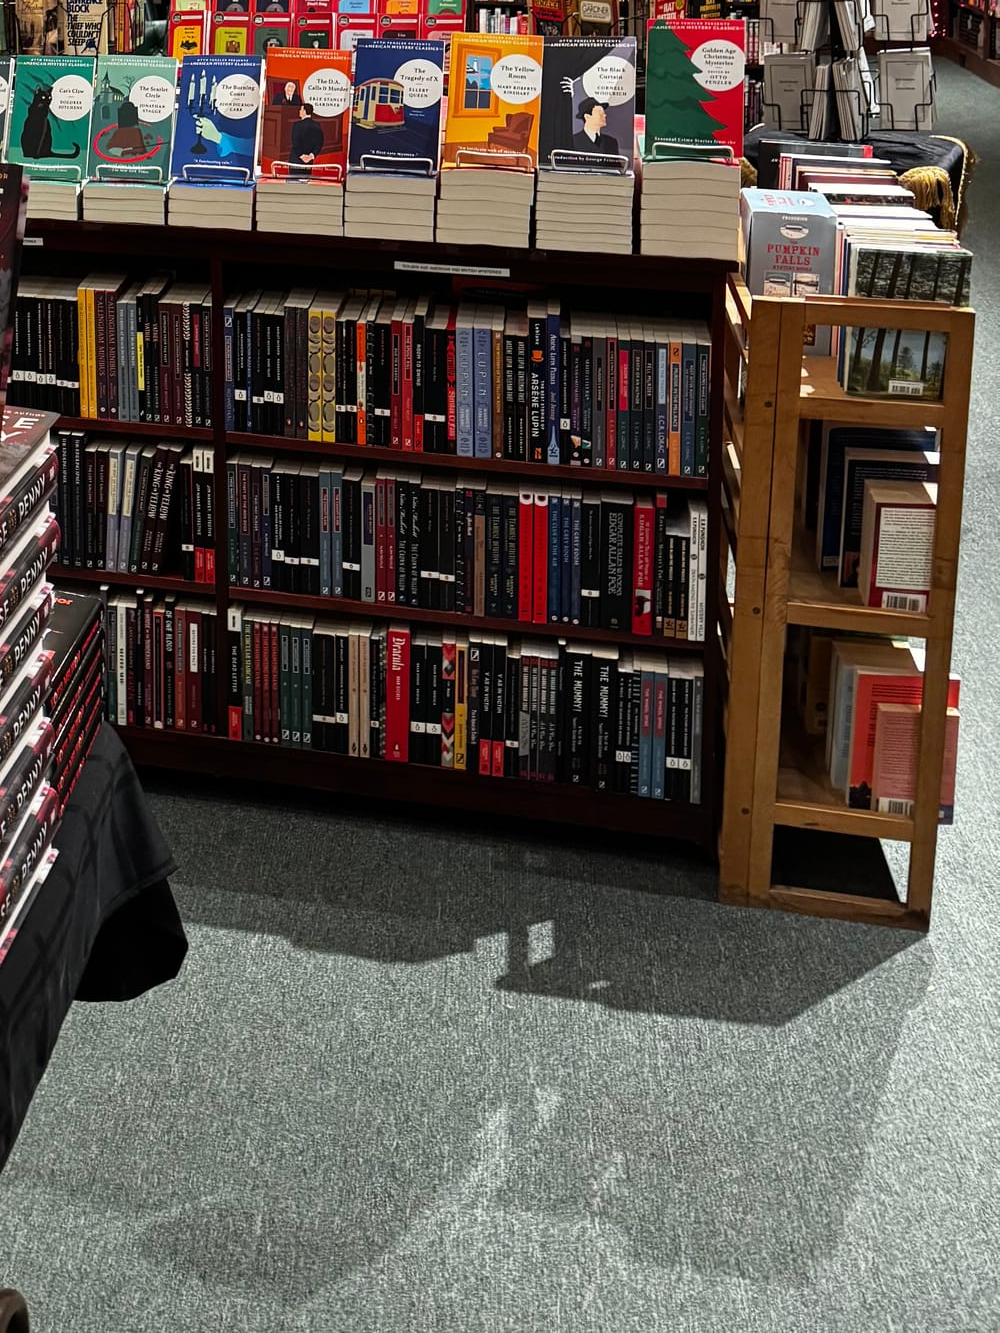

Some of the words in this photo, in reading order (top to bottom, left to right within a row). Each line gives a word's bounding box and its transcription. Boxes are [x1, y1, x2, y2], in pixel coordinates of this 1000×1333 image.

[67, 5, 90, 13] BLOCK
[767, 244, 819, 256] PUMPKIN
[775, 255, 811, 265] FALLS
[531, 411, 539, 437] LUPIN
[18, 473, 46, 521] PENNY
[609, 512, 617, 546] EDGAR
[20, 546, 48, 598] PENNY
[392, 636, 406, 671] Dracula
[574, 660, 583, 677] THE
